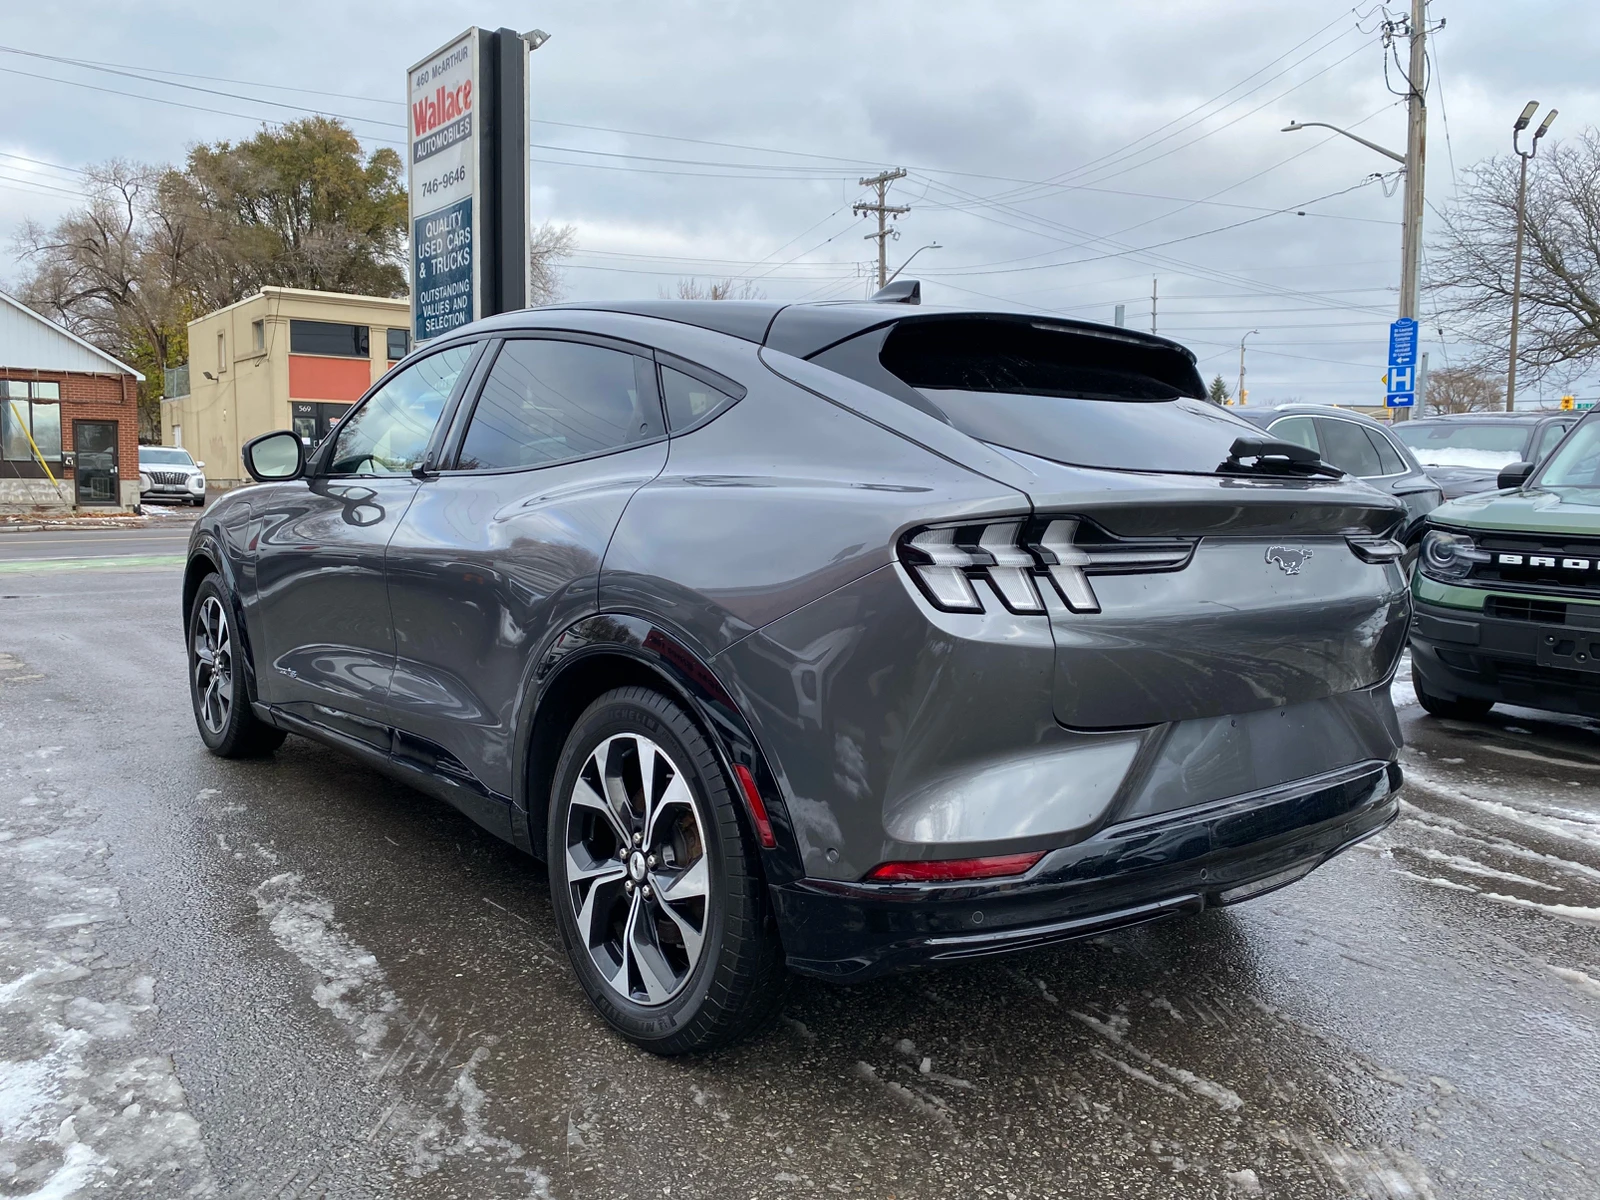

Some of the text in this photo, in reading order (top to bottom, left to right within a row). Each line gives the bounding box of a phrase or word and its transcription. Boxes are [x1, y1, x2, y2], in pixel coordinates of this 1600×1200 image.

[416, 46, 468, 87] 460 McARTHUR
[412, 79, 472, 137] Wallace
[416, 118, 470, 158] AUTOMOBILES
[422, 165, 466, 197] 746-9646
[425, 210, 463, 237] QUALITY
[418, 227, 471, 259] USED CARS
[419, 247, 470, 278] & TRUCKS
[420, 279, 470, 304] OUTSTANDING
[422, 295, 468, 318] VALUES AND
[425, 311, 465, 332] SELECTION
[1391, 367, 1411, 391] H
[1498, 554, 1600, 571] BRO
[603, 708, 656, 731] ICHELIN
